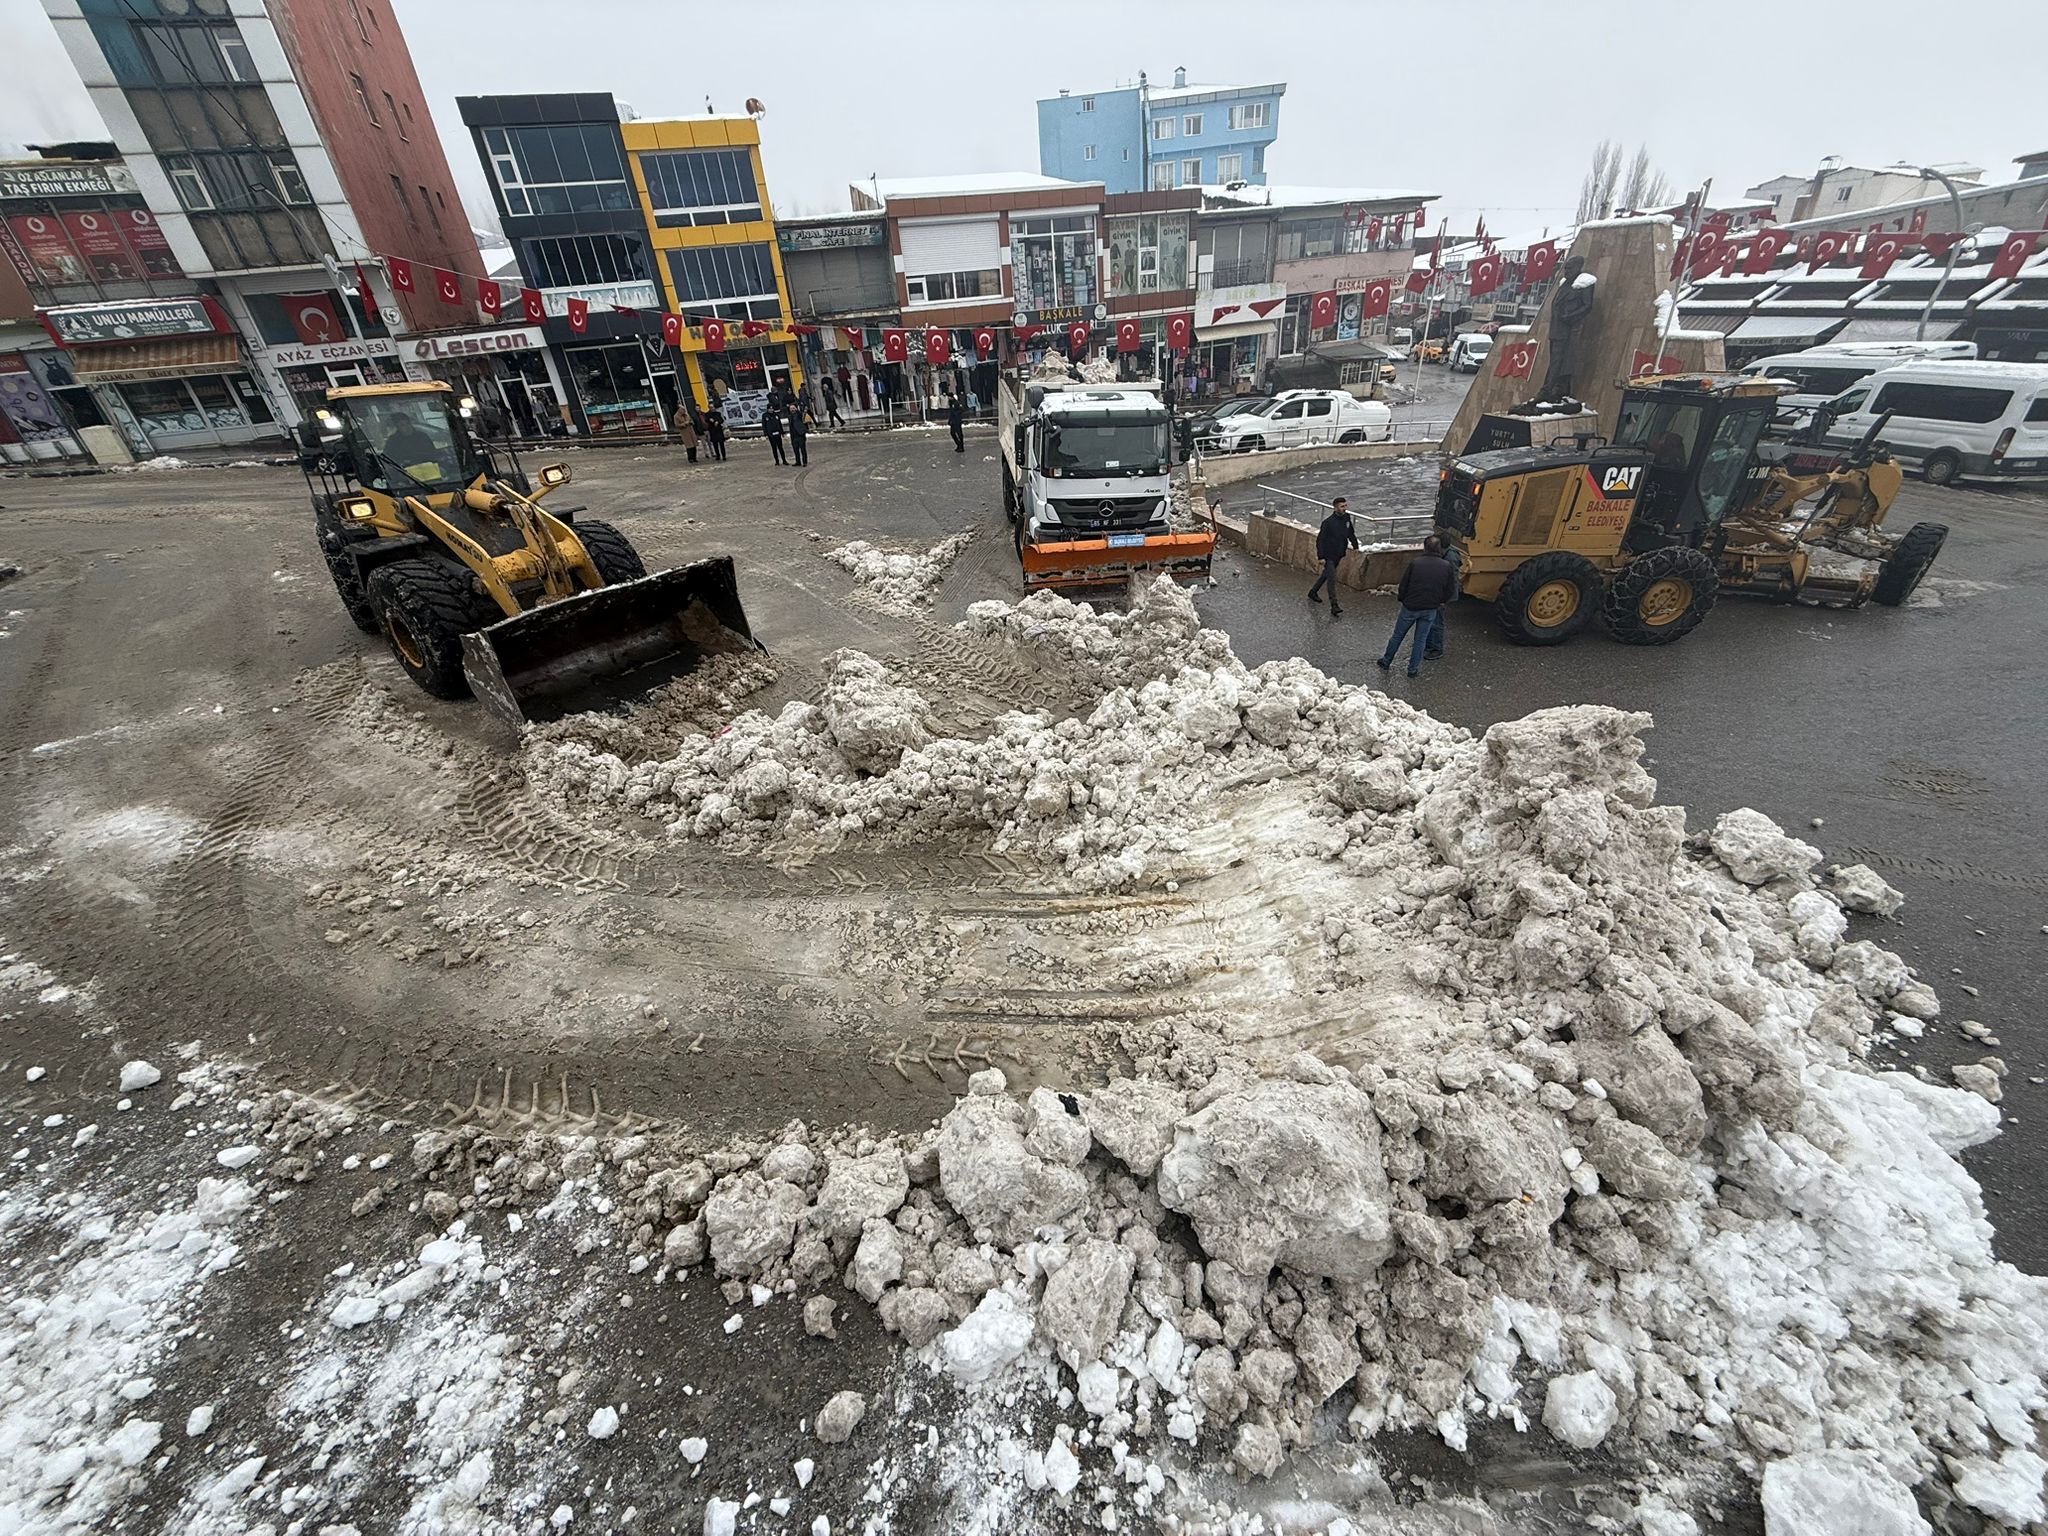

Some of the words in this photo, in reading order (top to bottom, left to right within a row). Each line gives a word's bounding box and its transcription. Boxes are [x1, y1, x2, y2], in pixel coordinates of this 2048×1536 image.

[4, 183, 30, 197] TAŞ
[31, 180, 66, 194] FIRIN
[65, 177, 111, 192] EKMEĞİ
[92, 314, 127, 327] UNLU
[126, 305, 196, 324] MAMÜLLERİ
[1039, 306, 1083, 322] BAŞKALE
[277, 350, 315, 363] AYAZ
[321, 342, 389, 359] ECZANESİ
[1602, 466, 1642, 491] CAT
